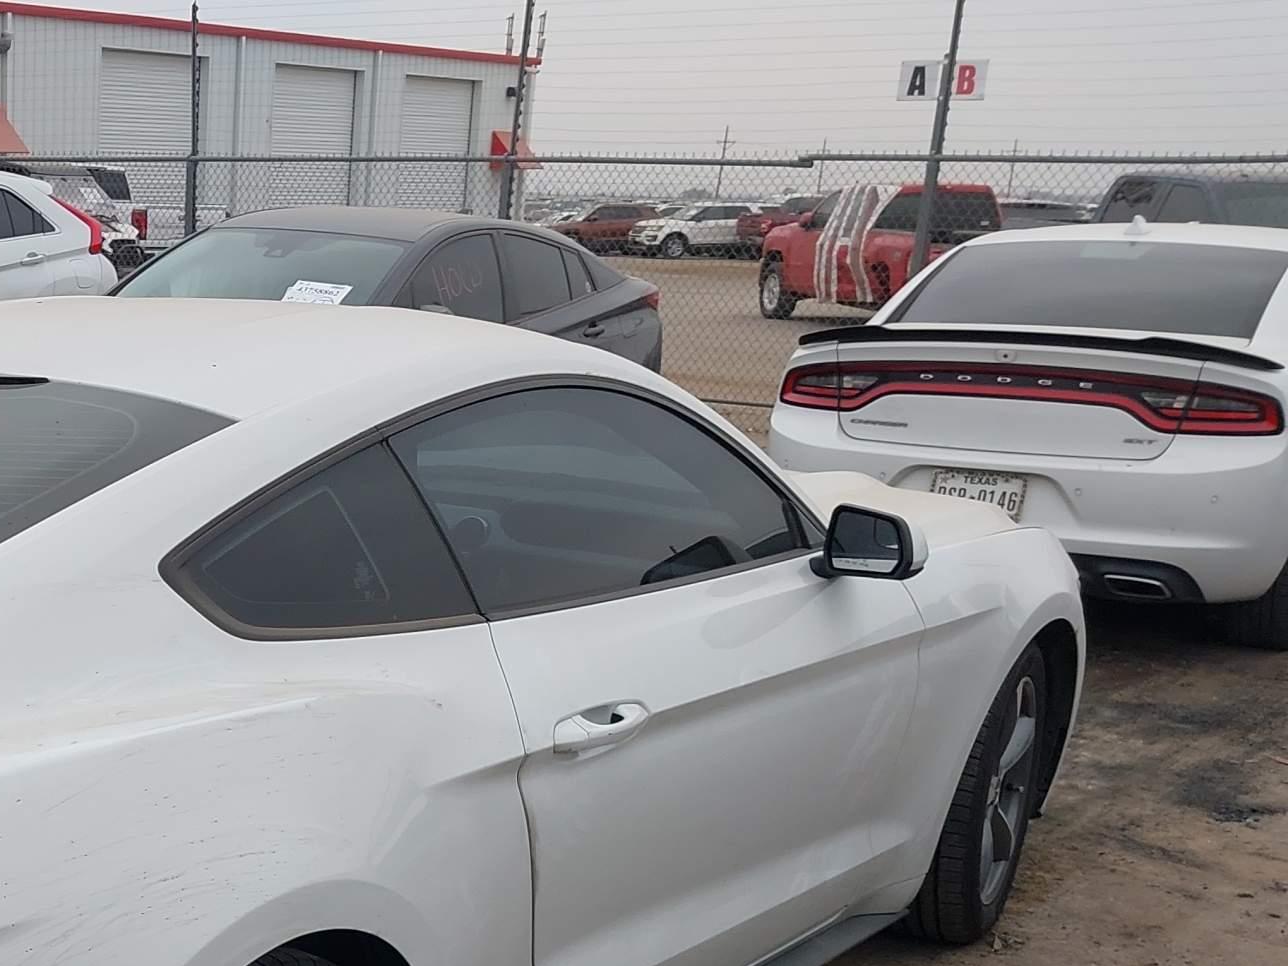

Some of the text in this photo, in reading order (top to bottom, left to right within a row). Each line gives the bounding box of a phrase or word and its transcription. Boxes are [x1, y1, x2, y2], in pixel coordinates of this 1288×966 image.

[907, 65, 977, 96] A B
[919, 373, 1094, 390] DODGE
[963, 475, 999, 486] TEXAS
